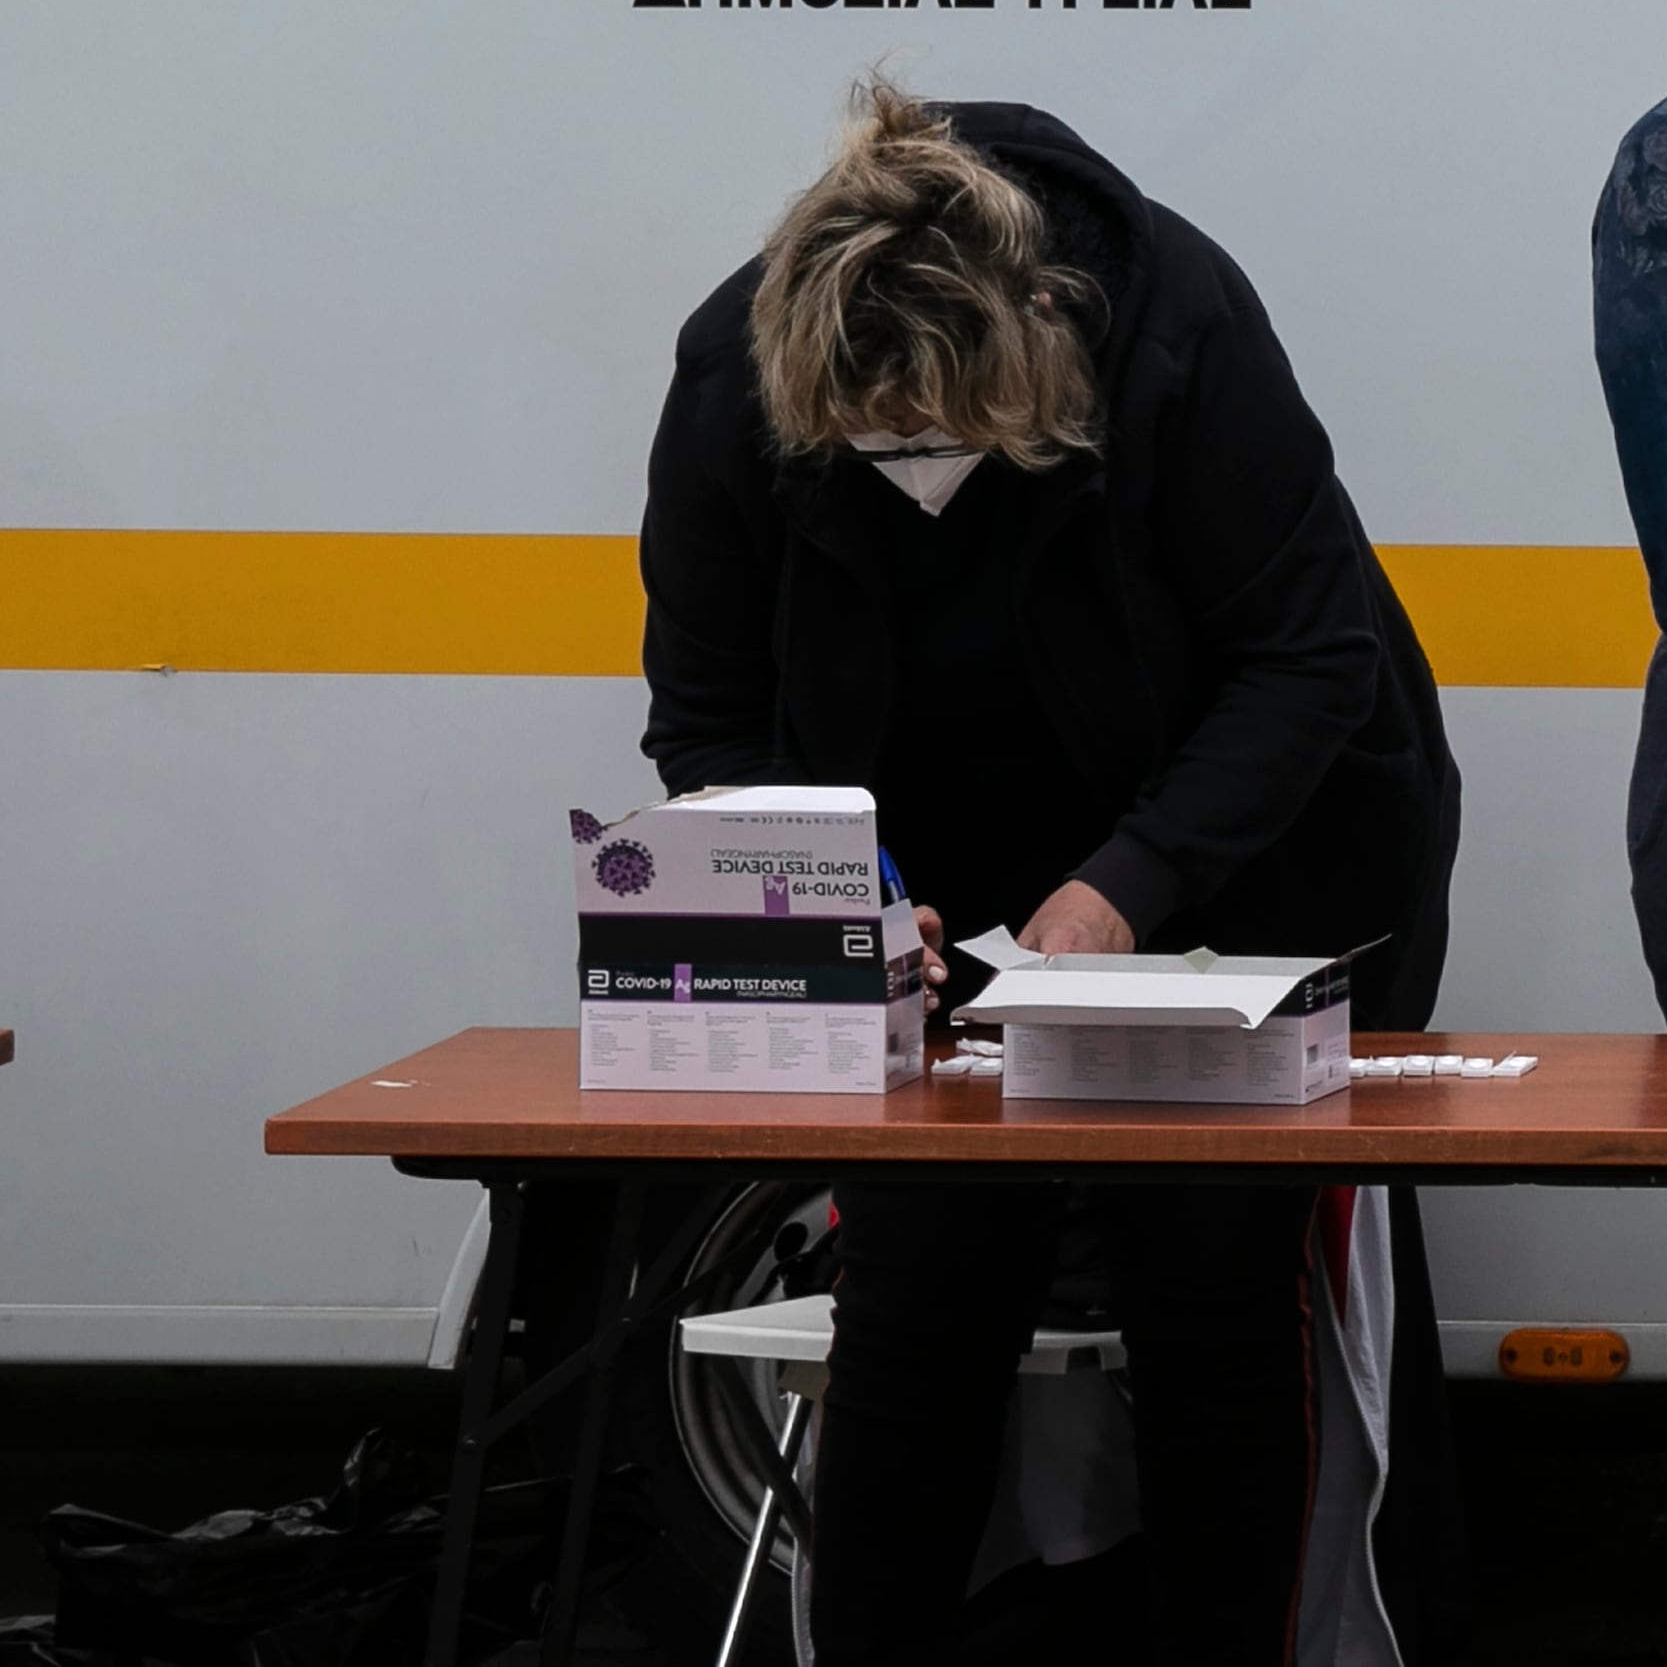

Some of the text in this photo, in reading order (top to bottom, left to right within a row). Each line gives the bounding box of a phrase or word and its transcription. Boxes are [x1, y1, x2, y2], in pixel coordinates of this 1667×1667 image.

[712, 859, 868, 876] RAPID TEST DEVICE
[792, 882, 869, 896] COVID-19
[615, 977, 671, 989] COVID-19
[694, 979, 732, 990] RAPID
[733, 979, 760, 991] TEST
[762, 980, 807, 991] DEVICE
